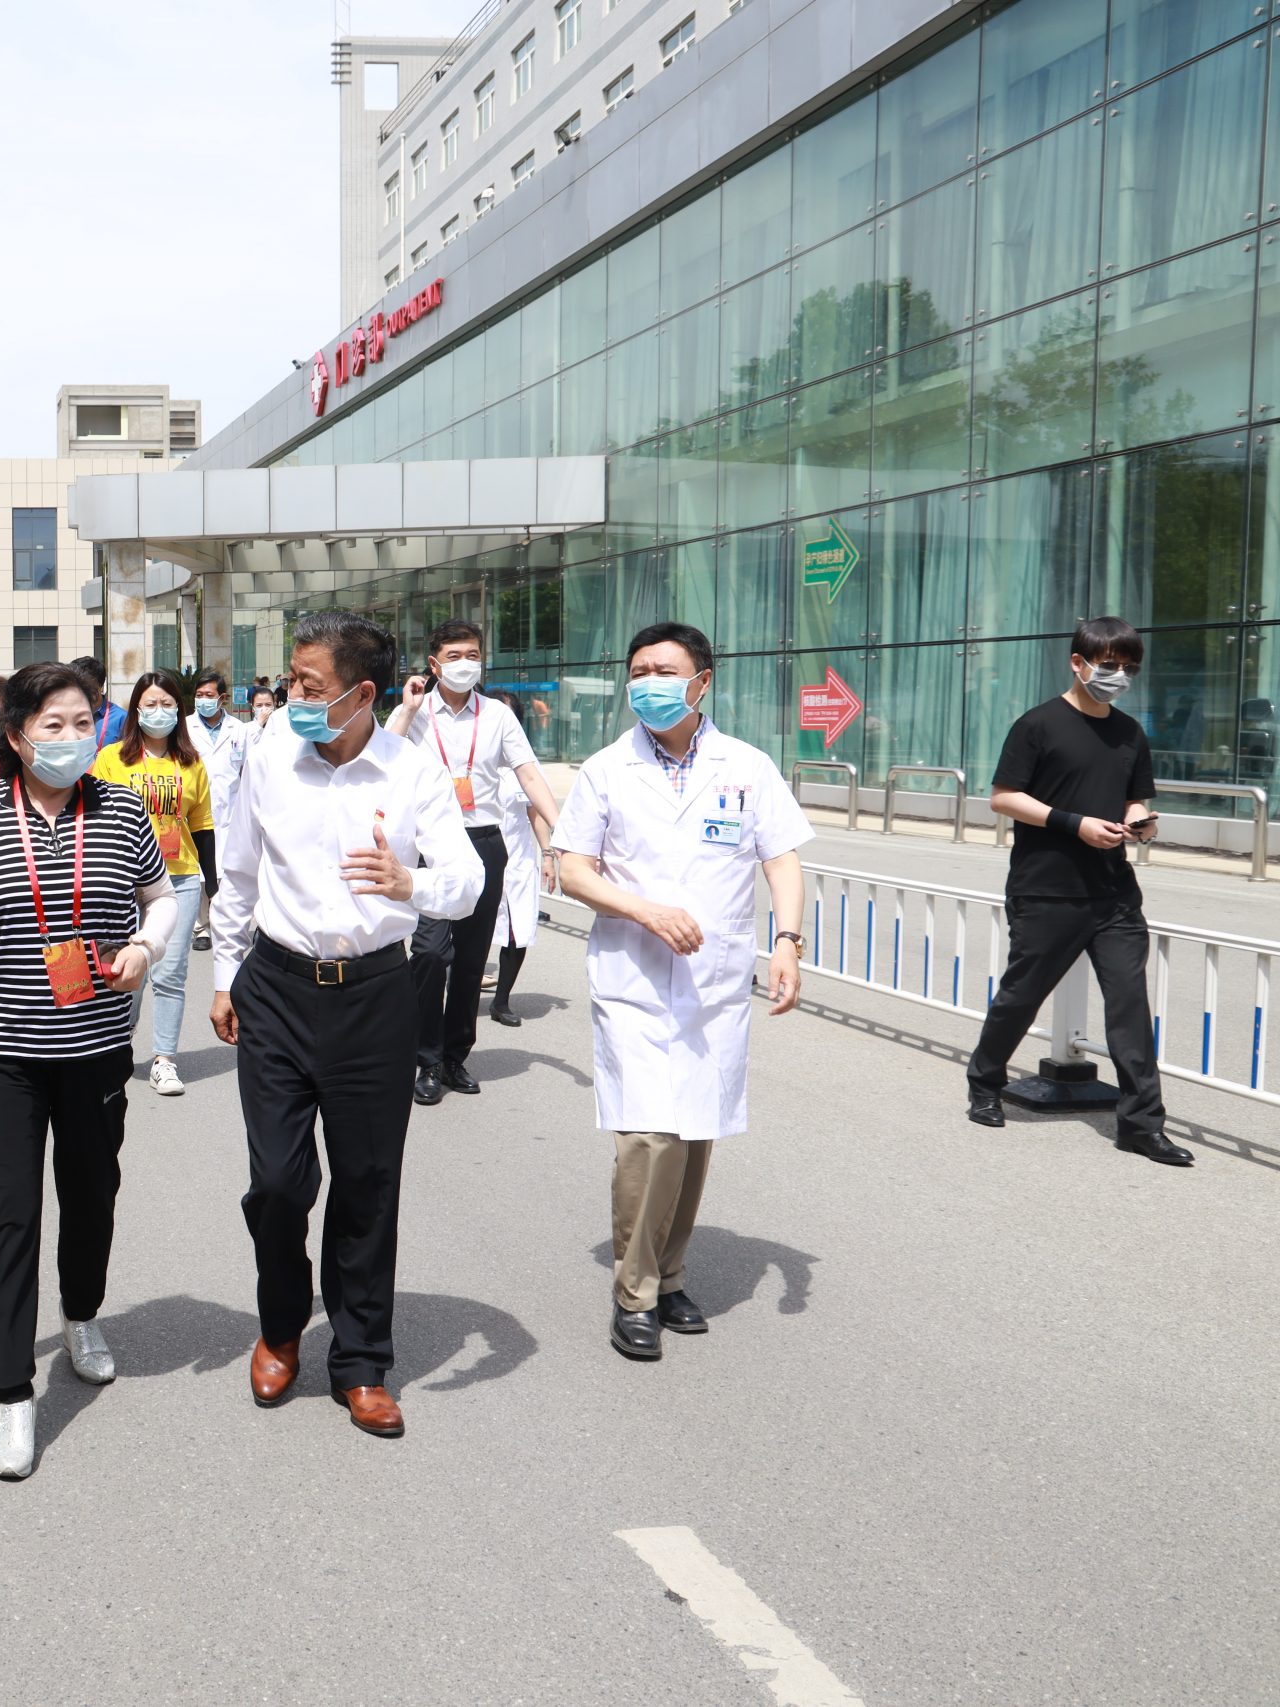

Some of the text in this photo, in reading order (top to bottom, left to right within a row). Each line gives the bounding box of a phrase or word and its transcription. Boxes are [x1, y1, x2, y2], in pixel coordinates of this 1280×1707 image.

[335, 278, 444, 388] 门诊部 OUTPATIENT
